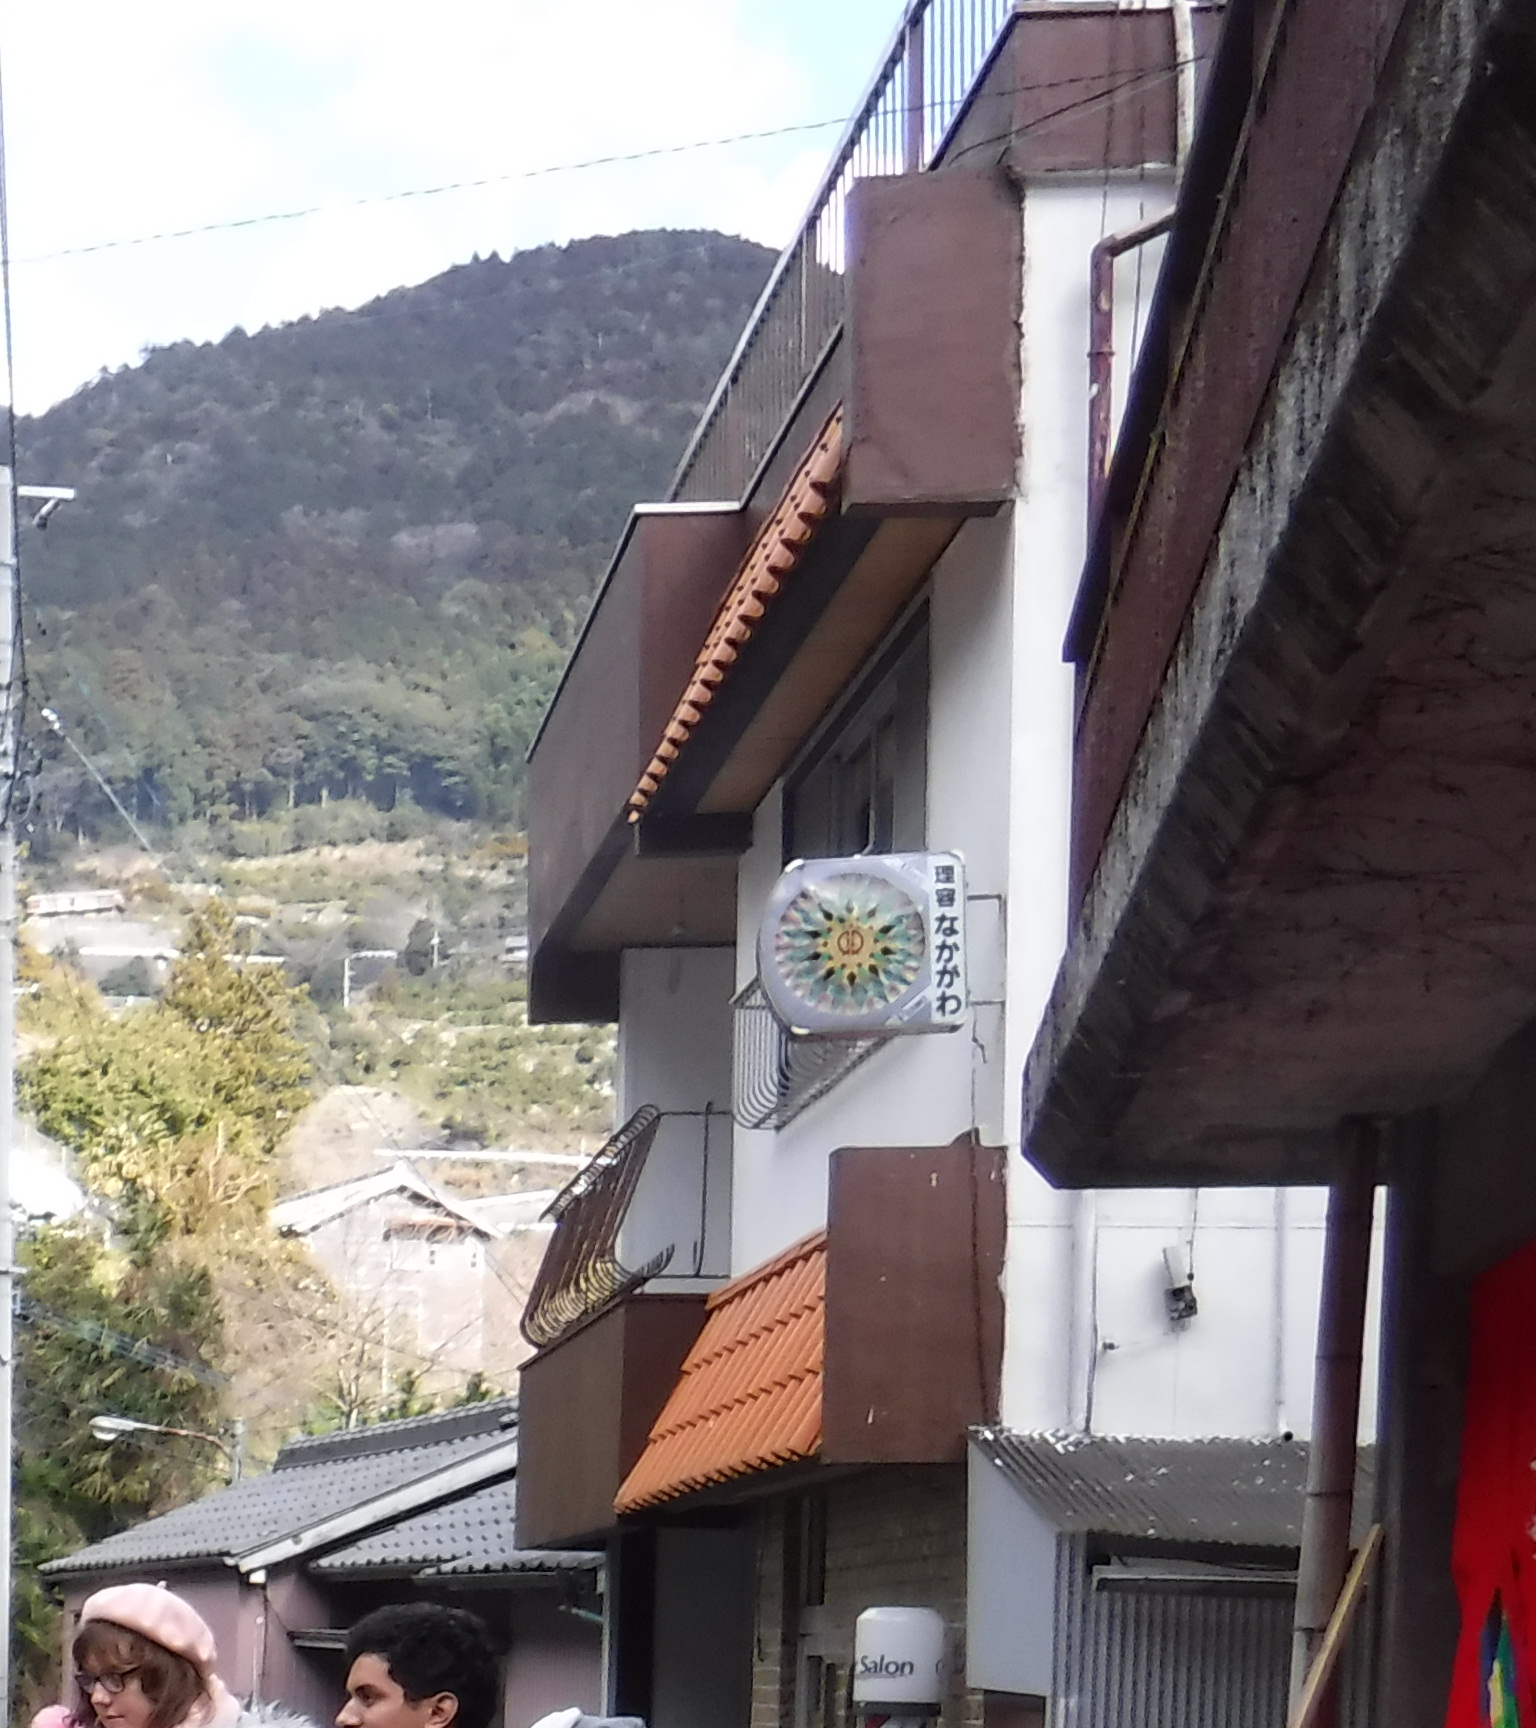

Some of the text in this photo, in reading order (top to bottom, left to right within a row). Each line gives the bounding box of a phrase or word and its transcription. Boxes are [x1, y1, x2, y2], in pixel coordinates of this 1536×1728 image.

[934, 865, 961, 1017] 理容なかがわ
[860, 1654, 914, 1676] Salon
